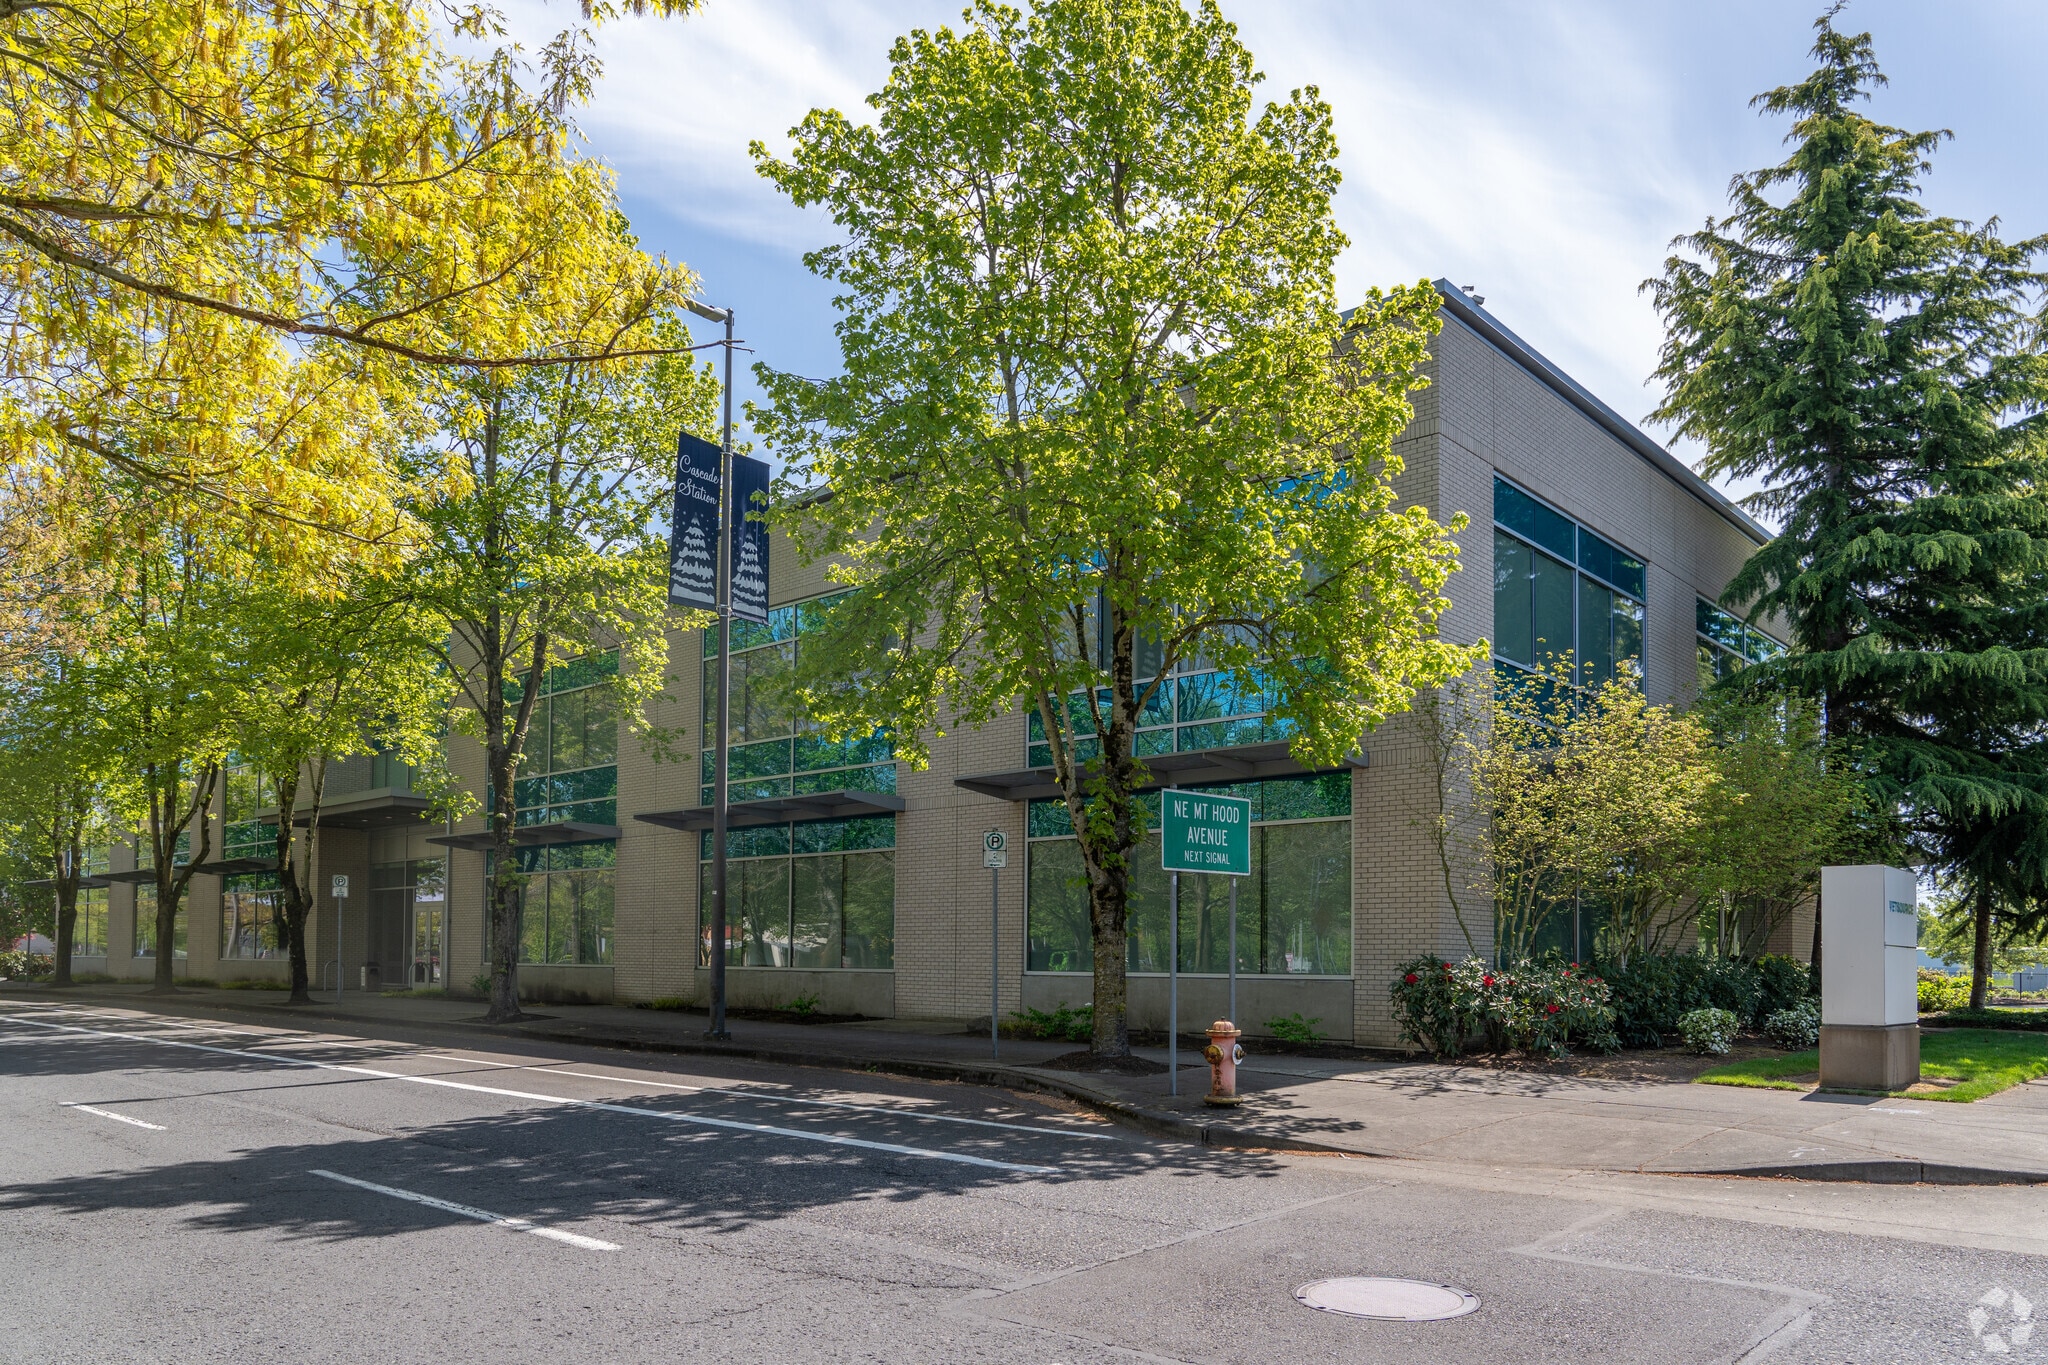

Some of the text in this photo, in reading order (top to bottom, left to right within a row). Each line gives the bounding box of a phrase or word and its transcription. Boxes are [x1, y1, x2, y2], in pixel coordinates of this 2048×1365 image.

[679, 454, 719, 485] Cascade
[678, 478, 718, 505] Station
[1174, 800, 1240, 824] NE MT HOOD
[992, 836, 1000, 846] P
[1187, 826, 1228, 847] AVENUE
[1184, 849, 1230, 865] NEXT SIGNAL
